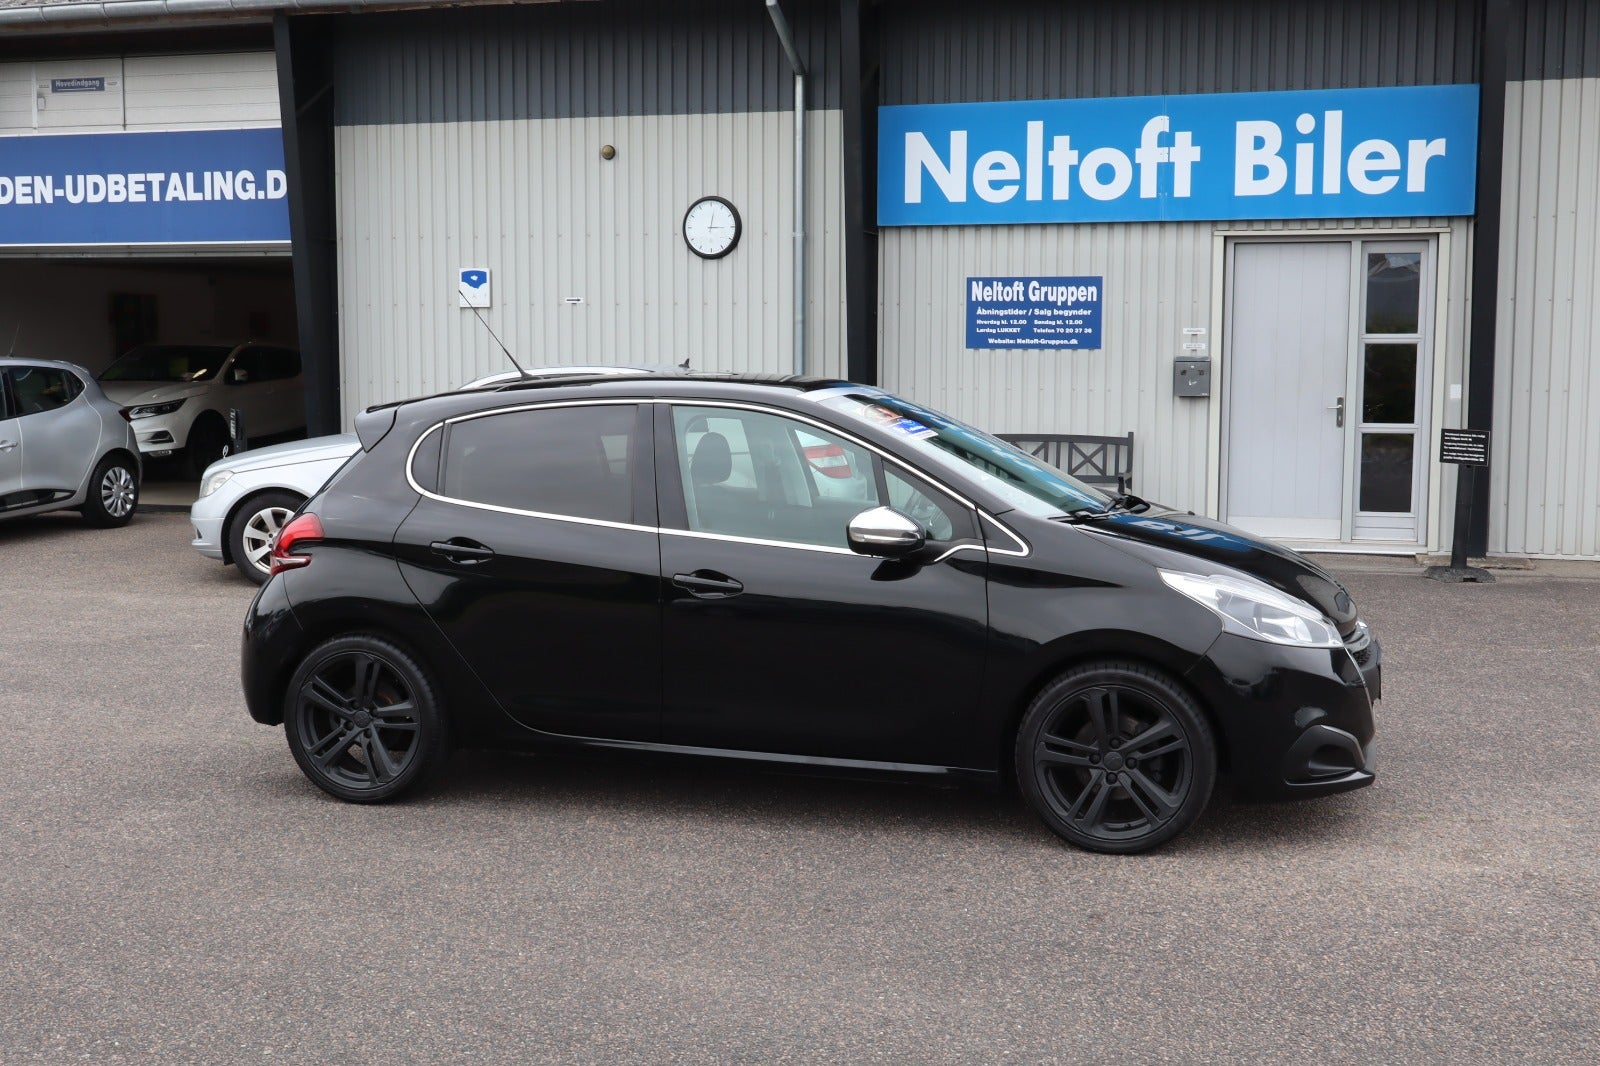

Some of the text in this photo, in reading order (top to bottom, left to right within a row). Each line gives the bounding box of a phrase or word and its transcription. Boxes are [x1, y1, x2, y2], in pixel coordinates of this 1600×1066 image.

[904, 110, 1446, 203] Neltoft Biler
[971, 280, 1097, 306] Neltoft Gruppen
[976, 306, 1092, 316] Åbningstider / Salg begynder
